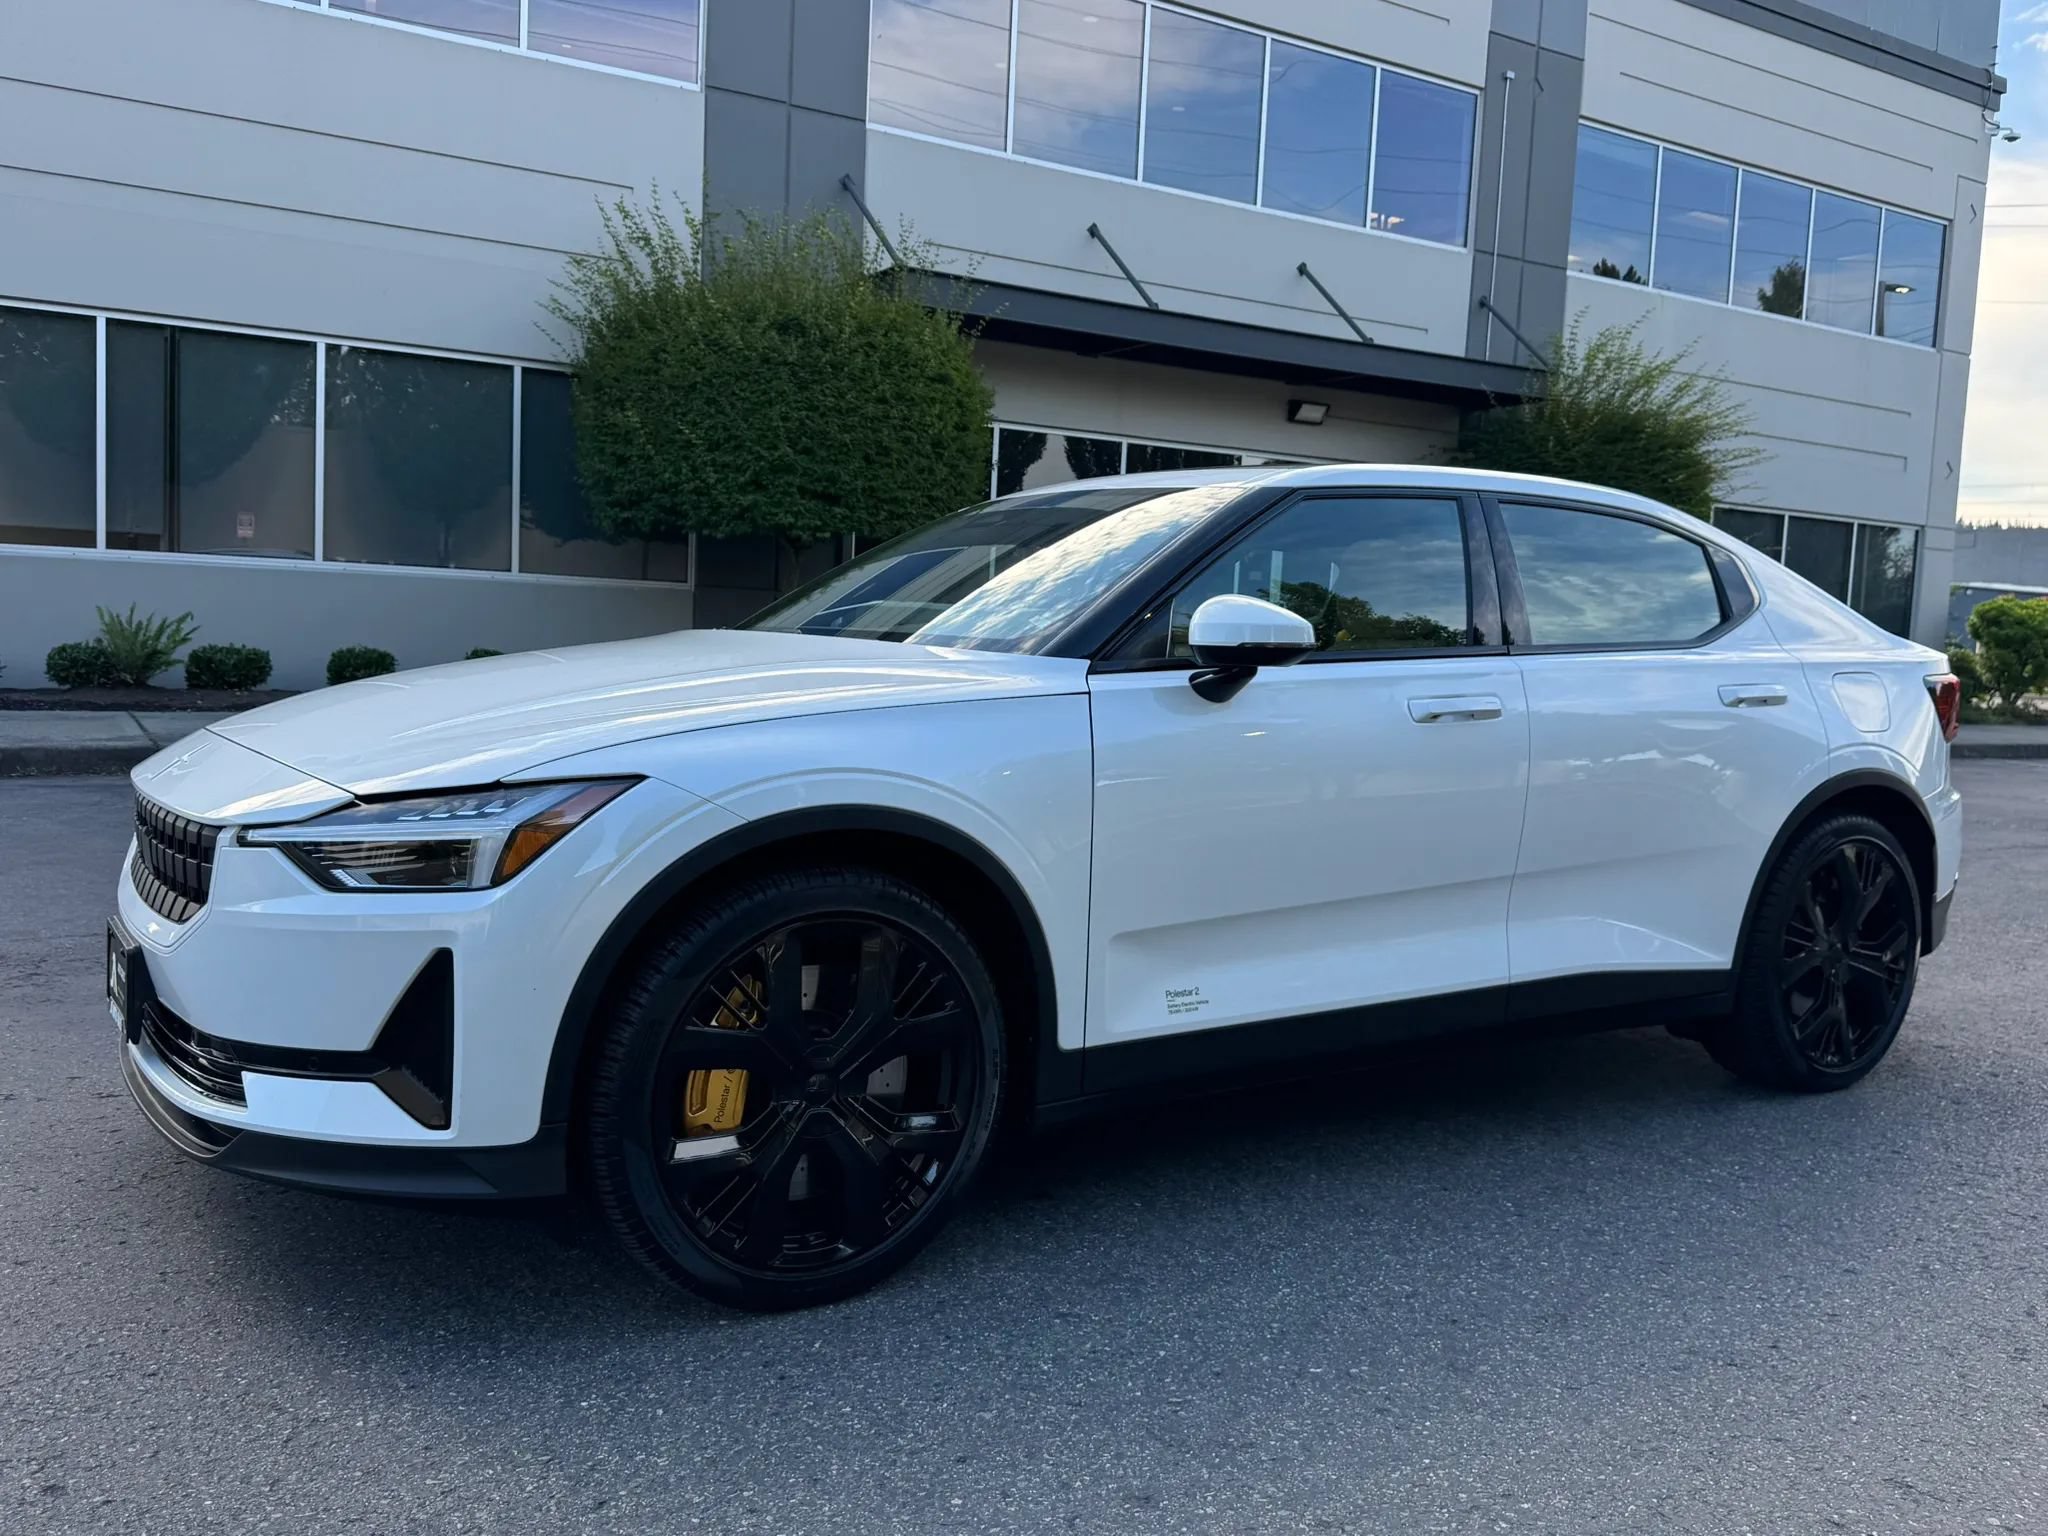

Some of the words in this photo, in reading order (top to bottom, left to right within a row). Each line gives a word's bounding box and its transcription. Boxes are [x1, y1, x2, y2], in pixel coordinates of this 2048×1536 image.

[1165, 989, 1194, 998] Polestar
[1194, 986, 1200, 995] 2
[714, 1084, 731, 1123] Polestar
